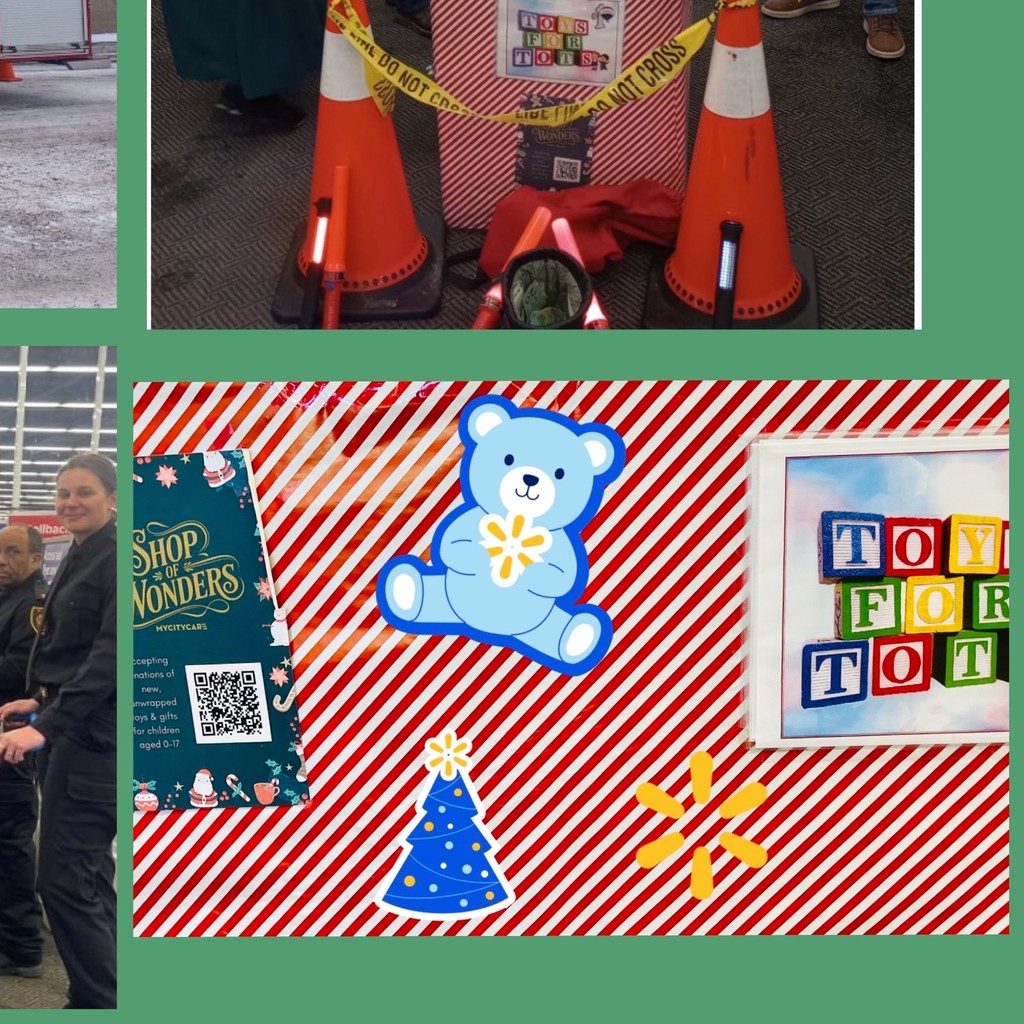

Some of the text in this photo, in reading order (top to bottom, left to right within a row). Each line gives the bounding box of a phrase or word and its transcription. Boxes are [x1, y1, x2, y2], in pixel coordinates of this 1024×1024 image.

[522, 12, 585, 32] TOYS
[527, 34, 579, 48] FOR
[517, 52, 591, 69] TOTS
[378, 54, 400, 76] DO
[398, 71, 430, 97] NOT
[607, 74, 644, 105] NOT
[636, 38, 687, 87] CROSS
[133, 529, 198, 576] SHOP
[165, 563, 179, 579] OF
[133, 563, 242, 619] WONDERS
[855, 585, 1009, 629] FOR
[156, 623, 208, 632] MYCITYCARE
[166, 669, 175, 678] of
[141, 686, 162, 694] new,
[150, 712, 157, 721] &
[159, 711, 179, 722] gifts
[133, 726, 181, 735] for children
[139, 739, 180, 751] aged 0-17
